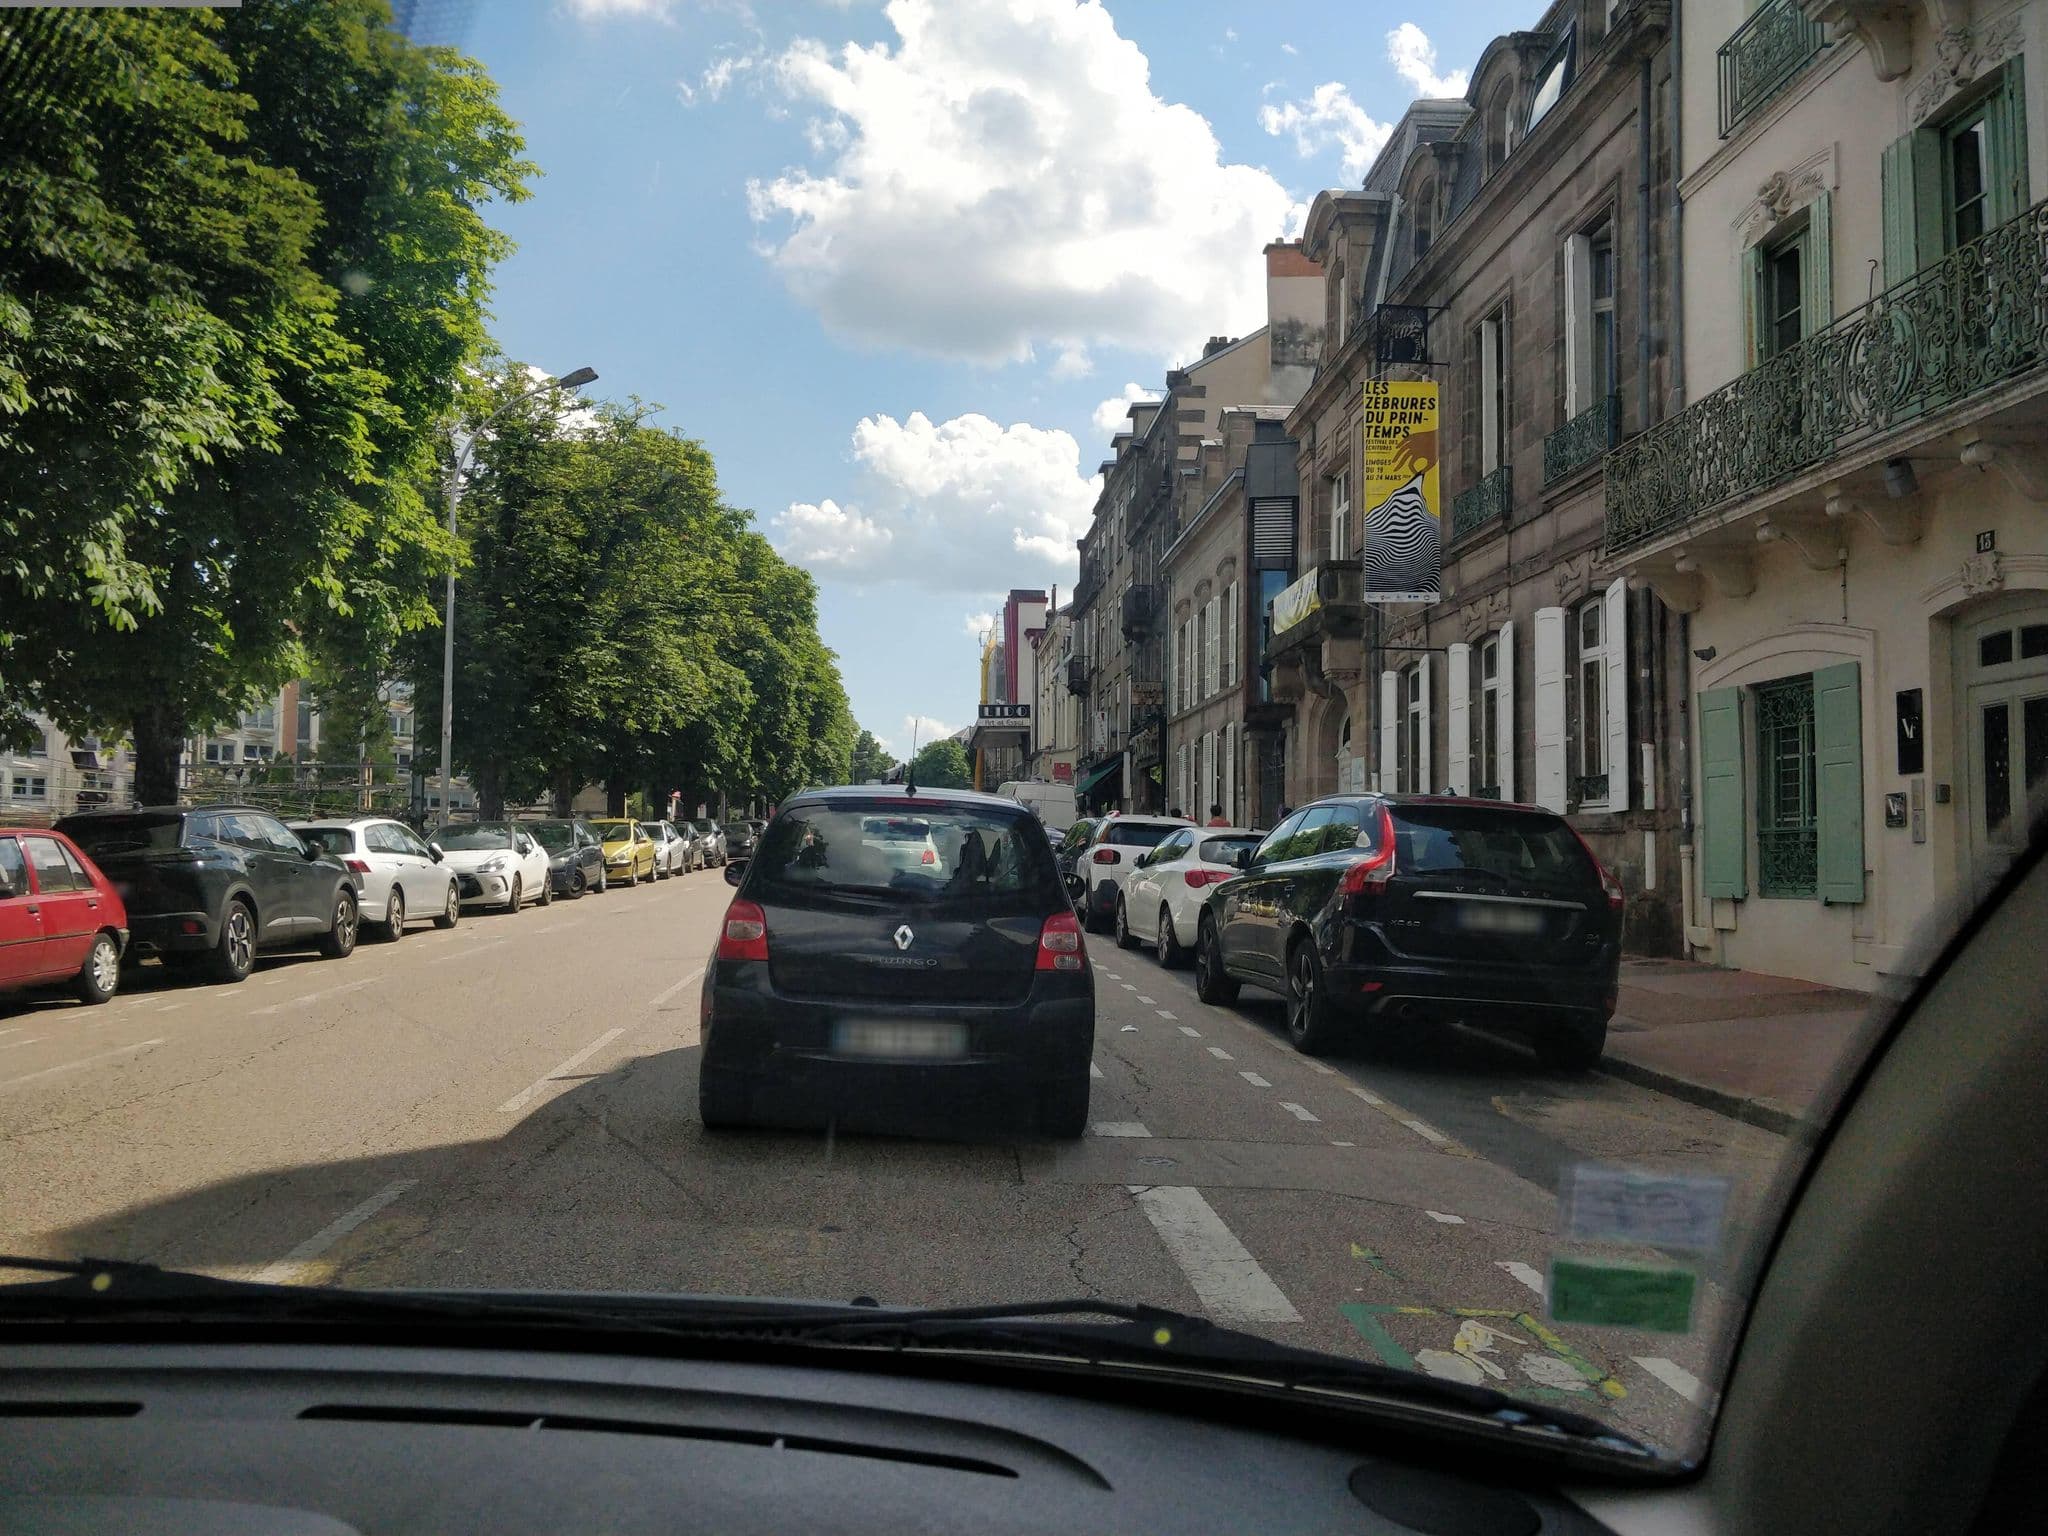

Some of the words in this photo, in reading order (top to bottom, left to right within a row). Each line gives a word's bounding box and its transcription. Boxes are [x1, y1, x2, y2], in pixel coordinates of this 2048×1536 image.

[1365, 382, 1389, 394] LES
[1365, 411, 1385, 424] DU
[1390, 411, 1429, 424] PRIN-
[1365, 426, 1410, 438] TEMPS
[984, 706, 1027, 716] LIDO
[1455, 886, 1551, 898] VOLVO
